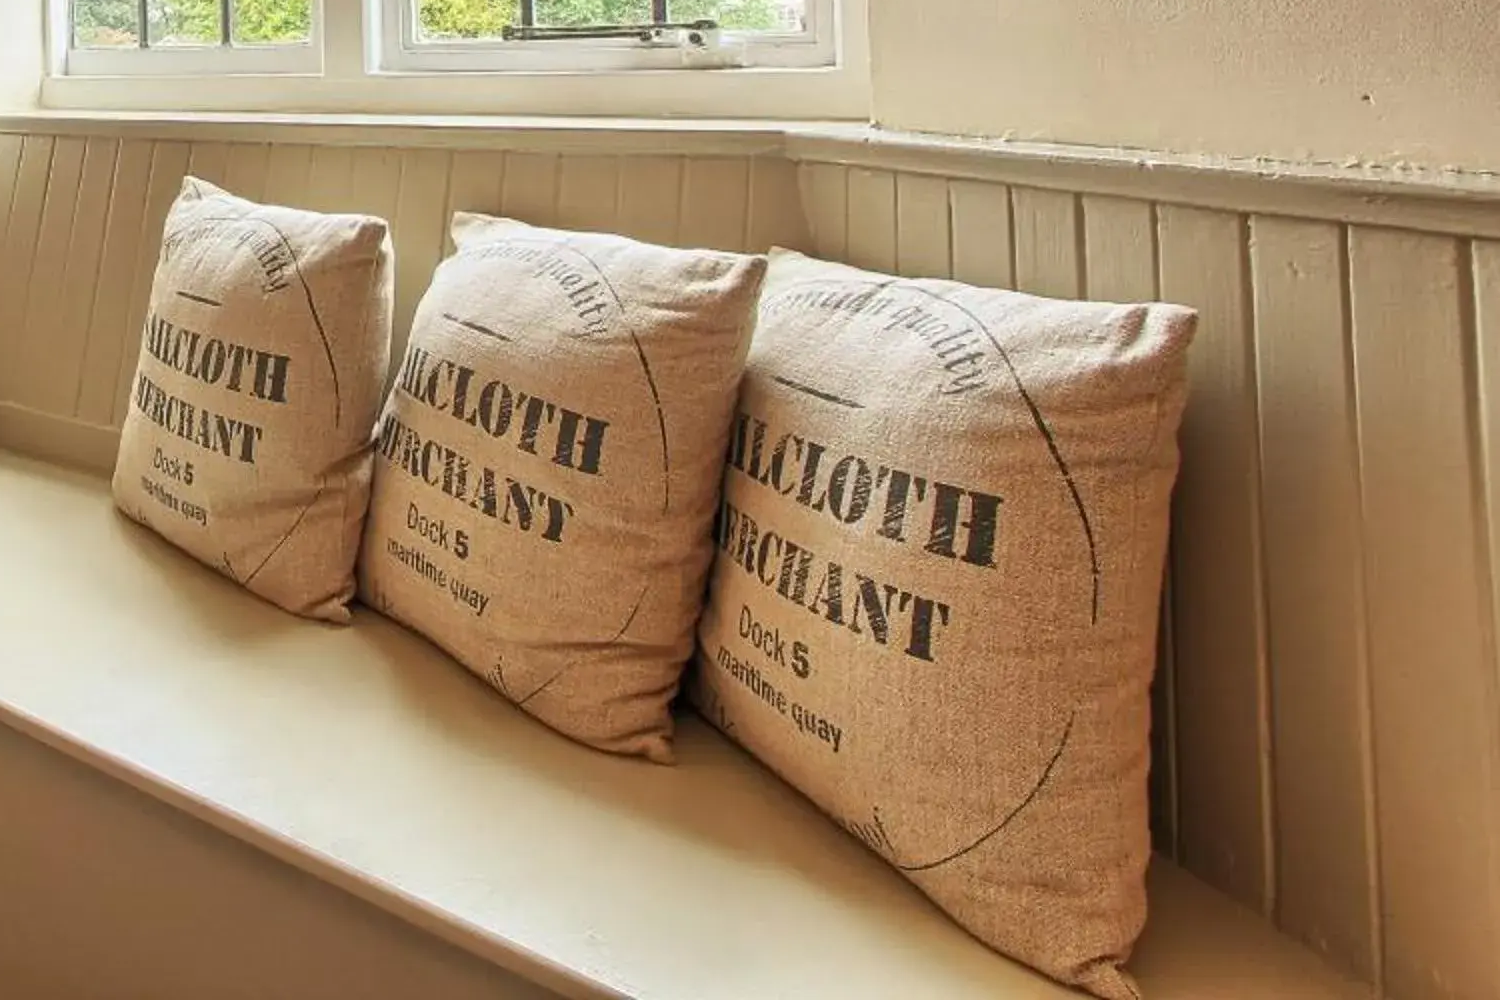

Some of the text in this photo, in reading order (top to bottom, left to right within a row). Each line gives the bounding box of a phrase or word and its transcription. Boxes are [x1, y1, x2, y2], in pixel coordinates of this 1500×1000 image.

[152, 446, 195, 485] Dock 5
[181, 495, 209, 527] quay
[406, 501, 470, 560] Dock 5
[386, 536, 490, 617] maritime quay
[714, 501, 949, 664] ERCHANT
[738, 603, 810, 679] Dock 5
[716, 645, 788, 715] maritime
[791, 704, 843, 753] quay
